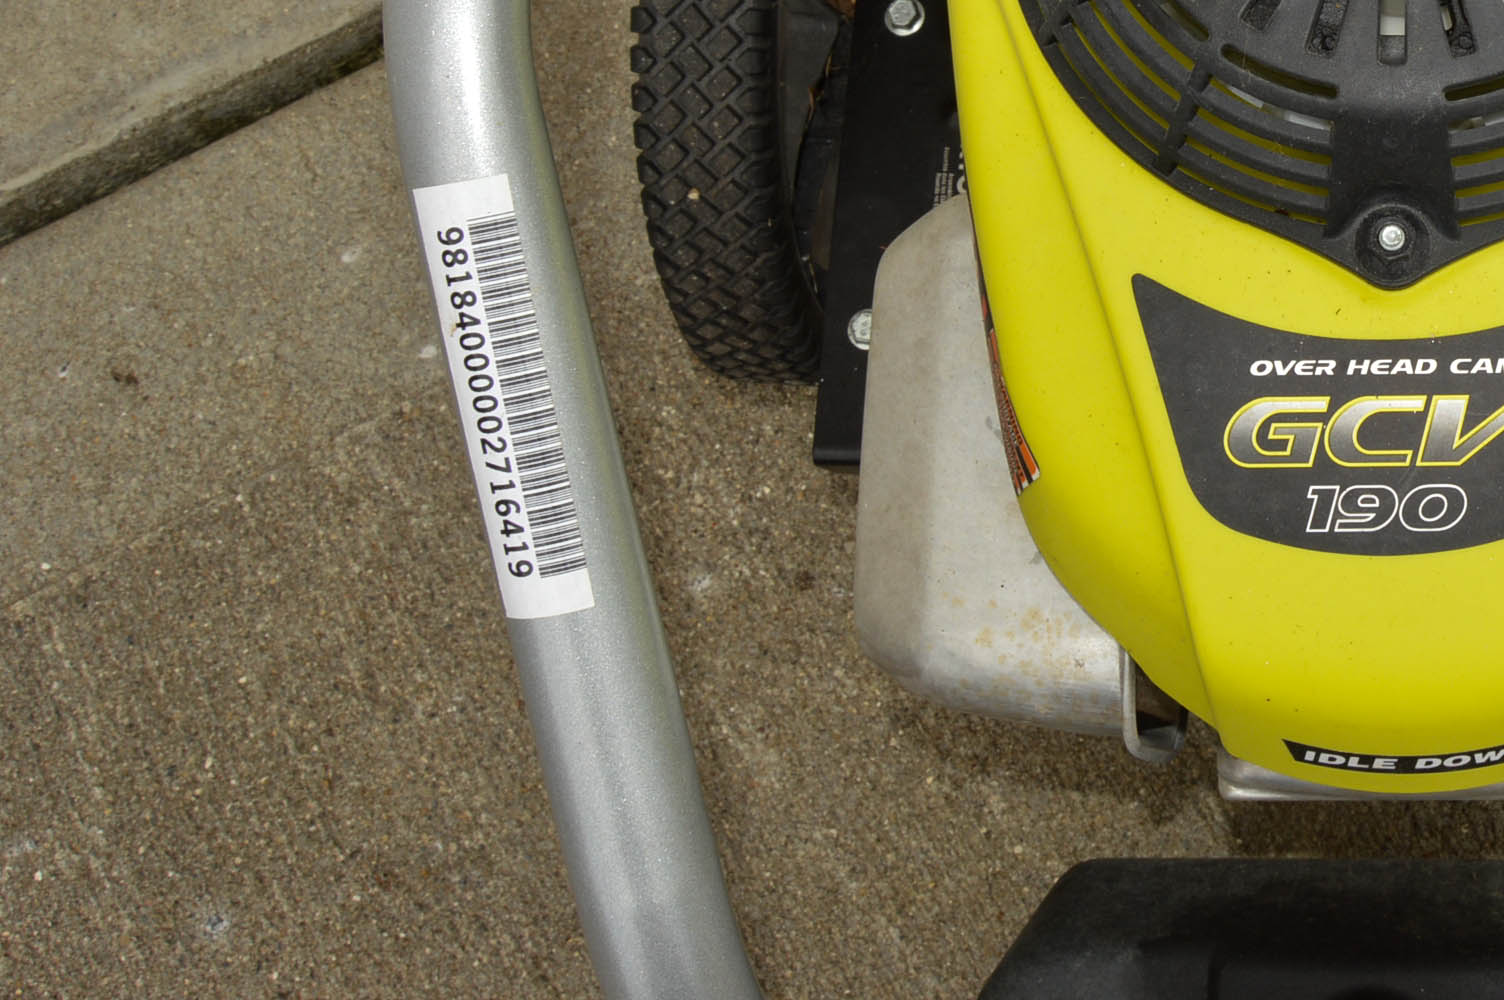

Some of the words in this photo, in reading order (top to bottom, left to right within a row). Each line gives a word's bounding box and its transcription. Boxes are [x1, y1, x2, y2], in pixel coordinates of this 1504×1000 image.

[1250, 360, 1336, 376] OVER
[1347, 358, 1438, 376] HEAD
[437, 226, 534, 578] 98184000002716419
[1306, 484, 1468, 532] 190
[1304, 751, 1398, 770] IDLE
